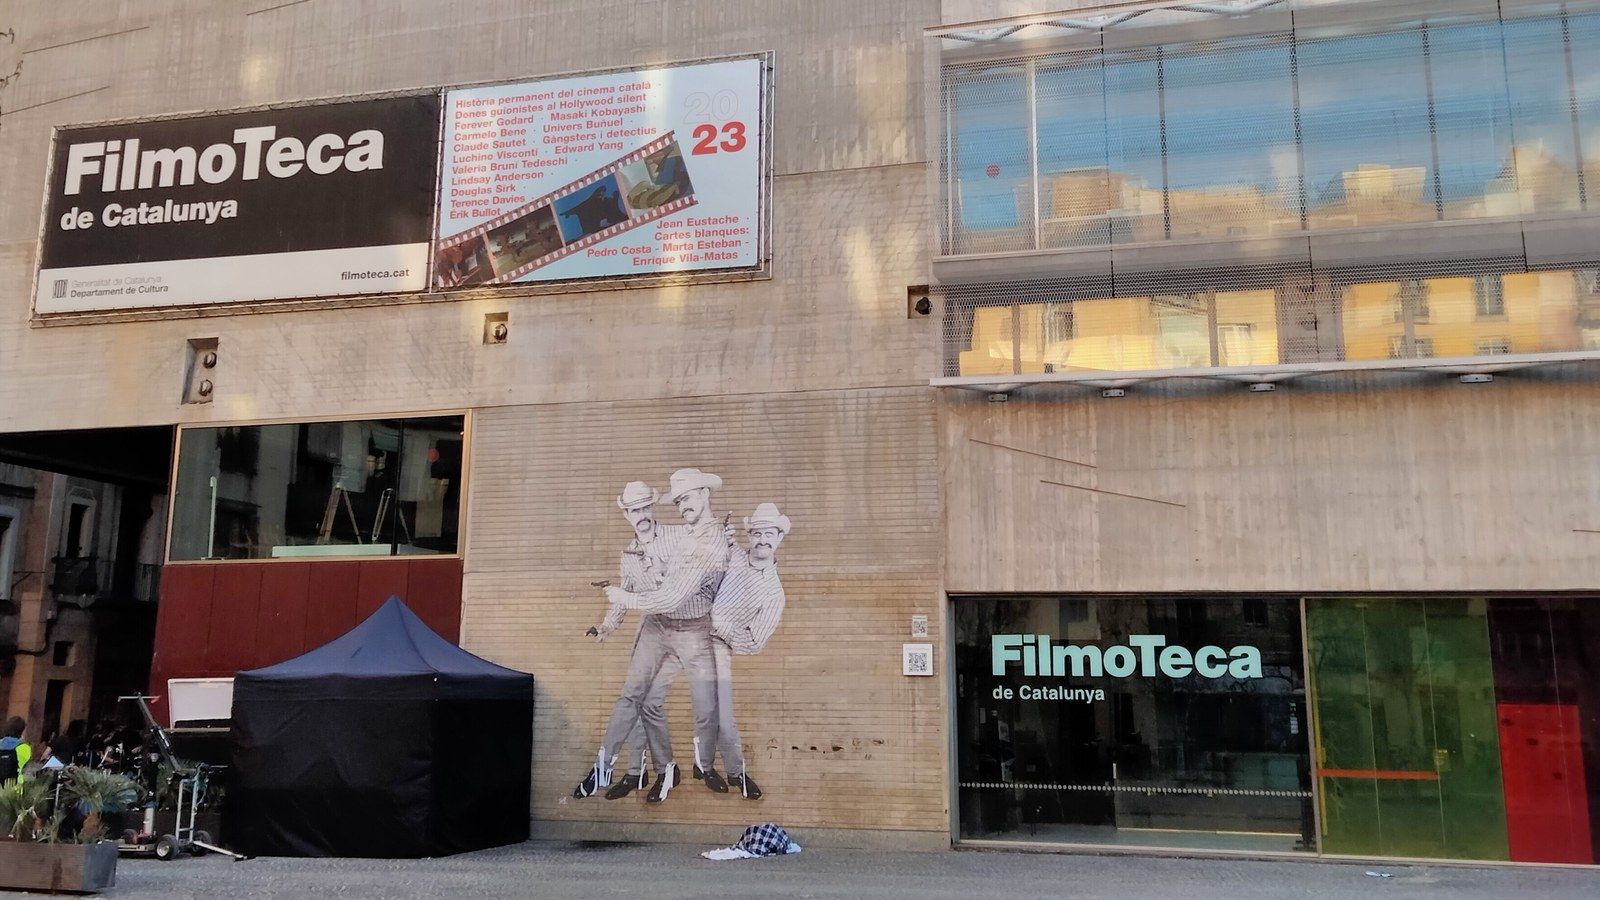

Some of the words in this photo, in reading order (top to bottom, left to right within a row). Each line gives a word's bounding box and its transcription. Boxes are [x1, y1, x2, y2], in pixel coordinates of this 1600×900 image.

[456, 98, 495, 108] Història
[498, 92, 554, 105] permanent
[558, 90, 574, 98] del
[577, 86, 615, 96] cinema
[618, 82, 651, 92] català
[455, 110, 487, 119] Dones
[490, 104, 544, 117] guionistes
[547, 102, 556, 110] al
[560, 96, 614, 109] Hollywood
[617, 93, 647, 104] silent
[455, 120, 493, 130] Forever
[496, 115, 534, 126] Godard
[550, 110, 588, 120] Masaki
[592, 104, 646, 117] Kobayashi
[454, 131, 497, 141] Carmelo
[500, 128, 526, 137] Bene
[543, 123, 582, 132] Univers
[454, 142, 489, 152] Claude
[492, 139, 526, 148] Sautet
[543, 133, 596, 144] Gàngsters
[606, 127, 656, 138] detectius
[692, 121, 746, 156] 23
[63, 125, 384, 196] FilmoTeca
[453, 154, 493, 163] Luchino
[497, 148, 538, 159] Visconti
[555, 143, 594, 154] Edward
[598, 142, 623, 150] Yang
[452, 165, 486, 174] Valeria
[490, 162, 518, 171] Bruni
[522, 157, 568, 168] Tedeschi
[452, 175, 490, 186] Lindsay
[494, 171, 544, 182] Anderson
[451, 187, 492, 197] Douglas
[496, 184, 516, 193] Sirk
[451, 198, 489, 208] Terence
[492, 195, 525, 204] Davies
[60, 207, 93, 231] de
[102, 199, 238, 228] Catalunya
[472, 208, 500, 218] Bullot
[657, 220, 682, 229] Jean
[687, 215, 739, 227] Eustache
[655, 231, 690, 241] Cartes
[695, 227, 749, 239] blanques:
[587, 248, 618, 257] Pedro
[621, 245, 652, 254] Costa
[662, 242, 693, 252] Marta
[697, 239, 741, 250] Esteban
[633, 255, 676, 267] Enrique
[679, 252, 738, 262] Vila-Matas
[341, 269, 410, 280] filmoteca.cat
[70, 287, 123, 299] Departament
[126, 286, 135, 294] de
[138, 284, 169, 294] Cultura
[992, 634, 1263, 679] FilmoTeca
[992, 685, 1013, 700] de
[1019, 685, 1105, 704] Catalunya
